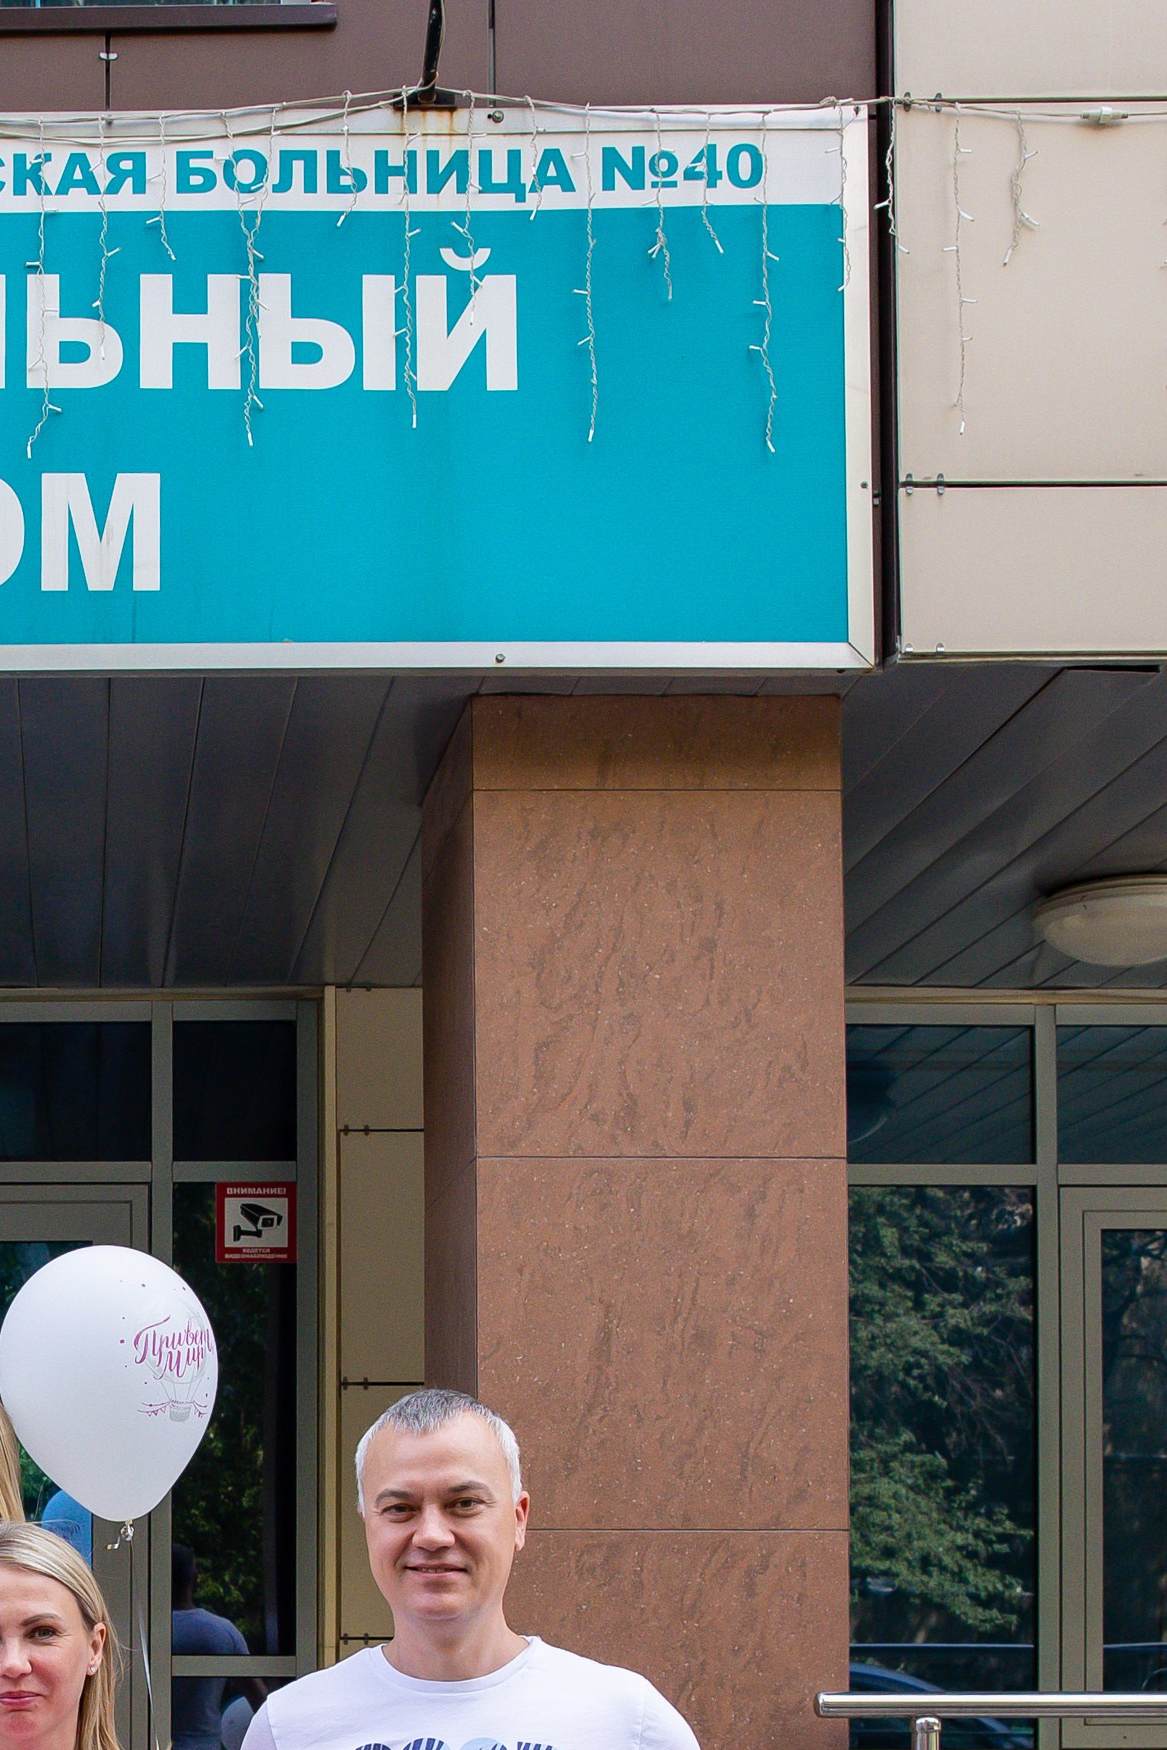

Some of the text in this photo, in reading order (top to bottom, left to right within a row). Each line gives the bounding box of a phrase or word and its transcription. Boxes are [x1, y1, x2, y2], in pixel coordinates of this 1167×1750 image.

[175, 148, 576, 203] БОЛЬНИЦА
[602, 142, 763, 191] №40
[226, 1187, 287, 1195] ВНИМАНИЕ!
